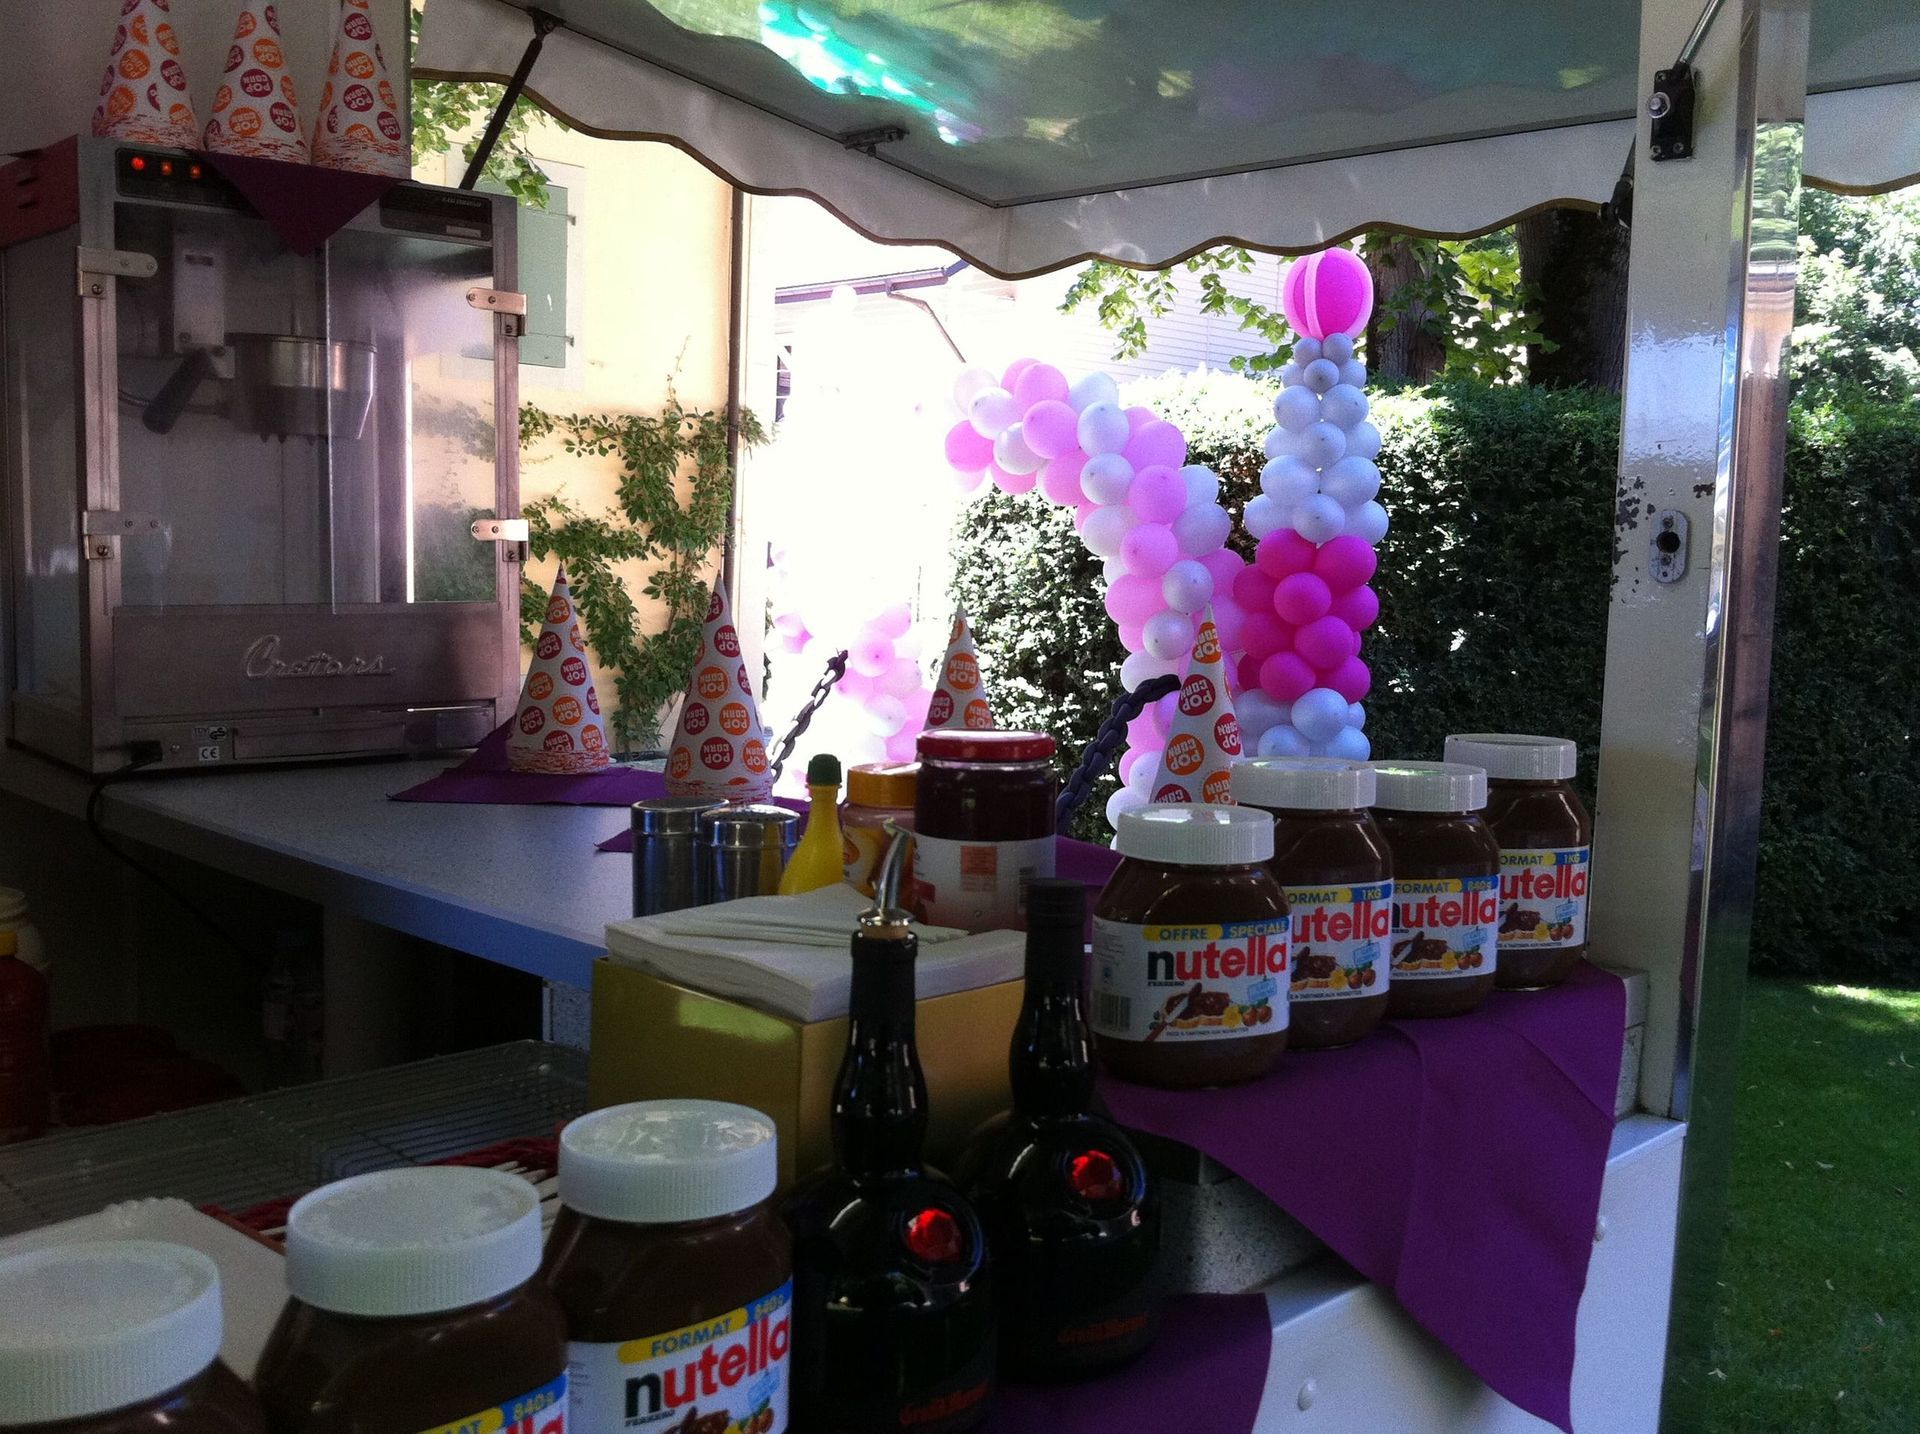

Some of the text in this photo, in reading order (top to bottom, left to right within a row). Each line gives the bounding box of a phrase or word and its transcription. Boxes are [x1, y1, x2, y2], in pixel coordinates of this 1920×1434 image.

[1182, 691, 1214, 711] POP
[704, 753, 731, 764] POP
[1171, 751, 1201, 770] POP
[1500, 864, 1586, 899] utella
[1288, 891, 1338, 904] ORMAT
[1159, 920, 1286, 941] OFFRE SPECIALE
[1292, 901, 1389, 943] utella
[1148, 935, 1287, 980] nutella
[652, 1318, 731, 1357] FORMAT
[625, 1314, 790, 1418] nutella
